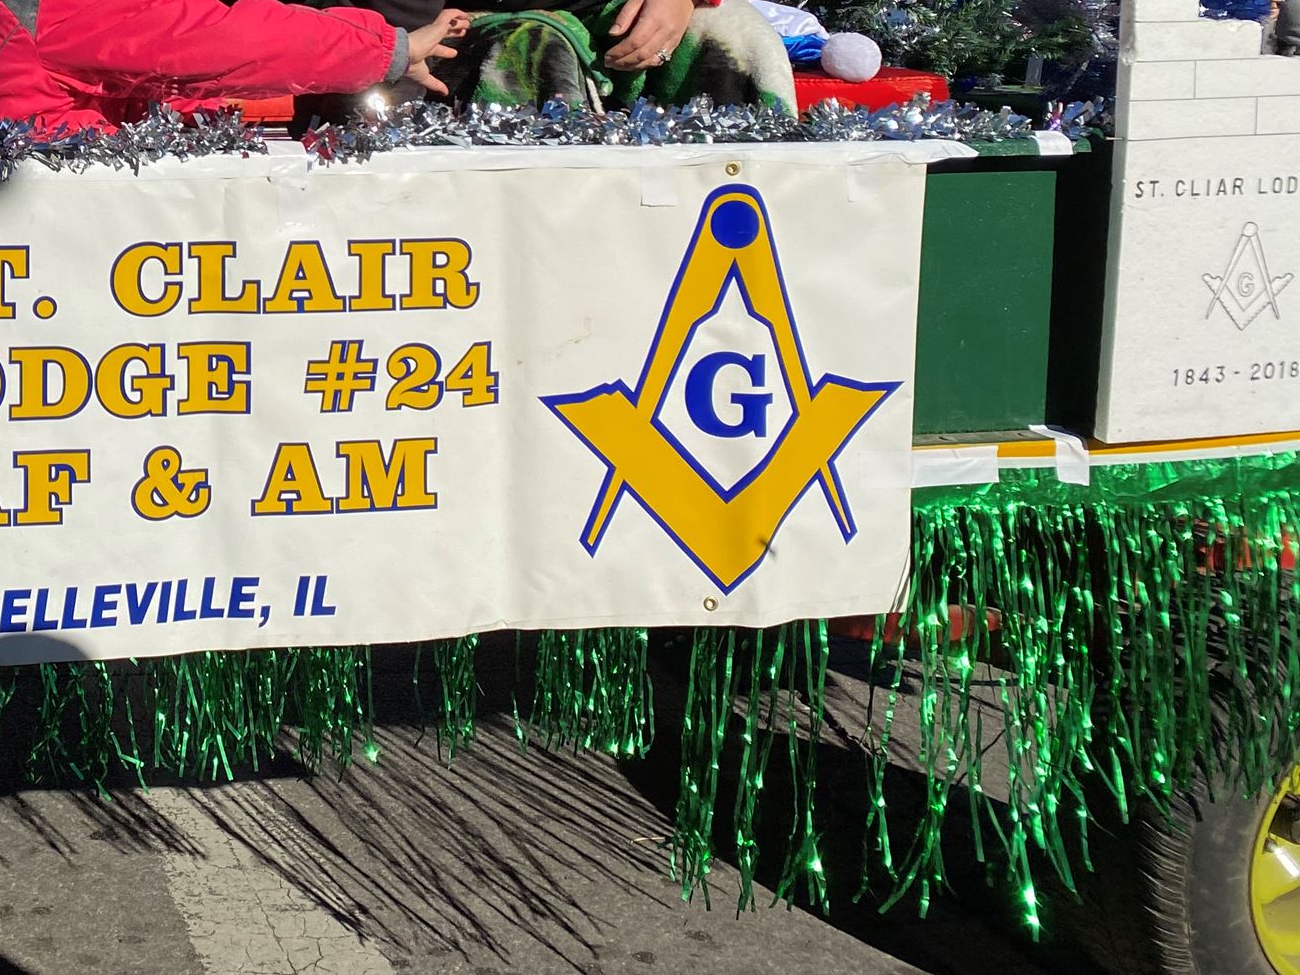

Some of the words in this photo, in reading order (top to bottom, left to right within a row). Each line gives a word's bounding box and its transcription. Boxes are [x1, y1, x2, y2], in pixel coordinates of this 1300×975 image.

[1134, 180, 1165, 199] ST.
[1175, 177, 1245, 198] CLIAR
[111, 238, 480, 317] CLAIR
[1236, 271, 1255, 298] G
[304, 339, 500, 413] #24
[685, 351, 773, 438] G
[132, 445, 212, 521] &
[251, 438, 438, 516] AM
[293, 576, 337, 617] IL
